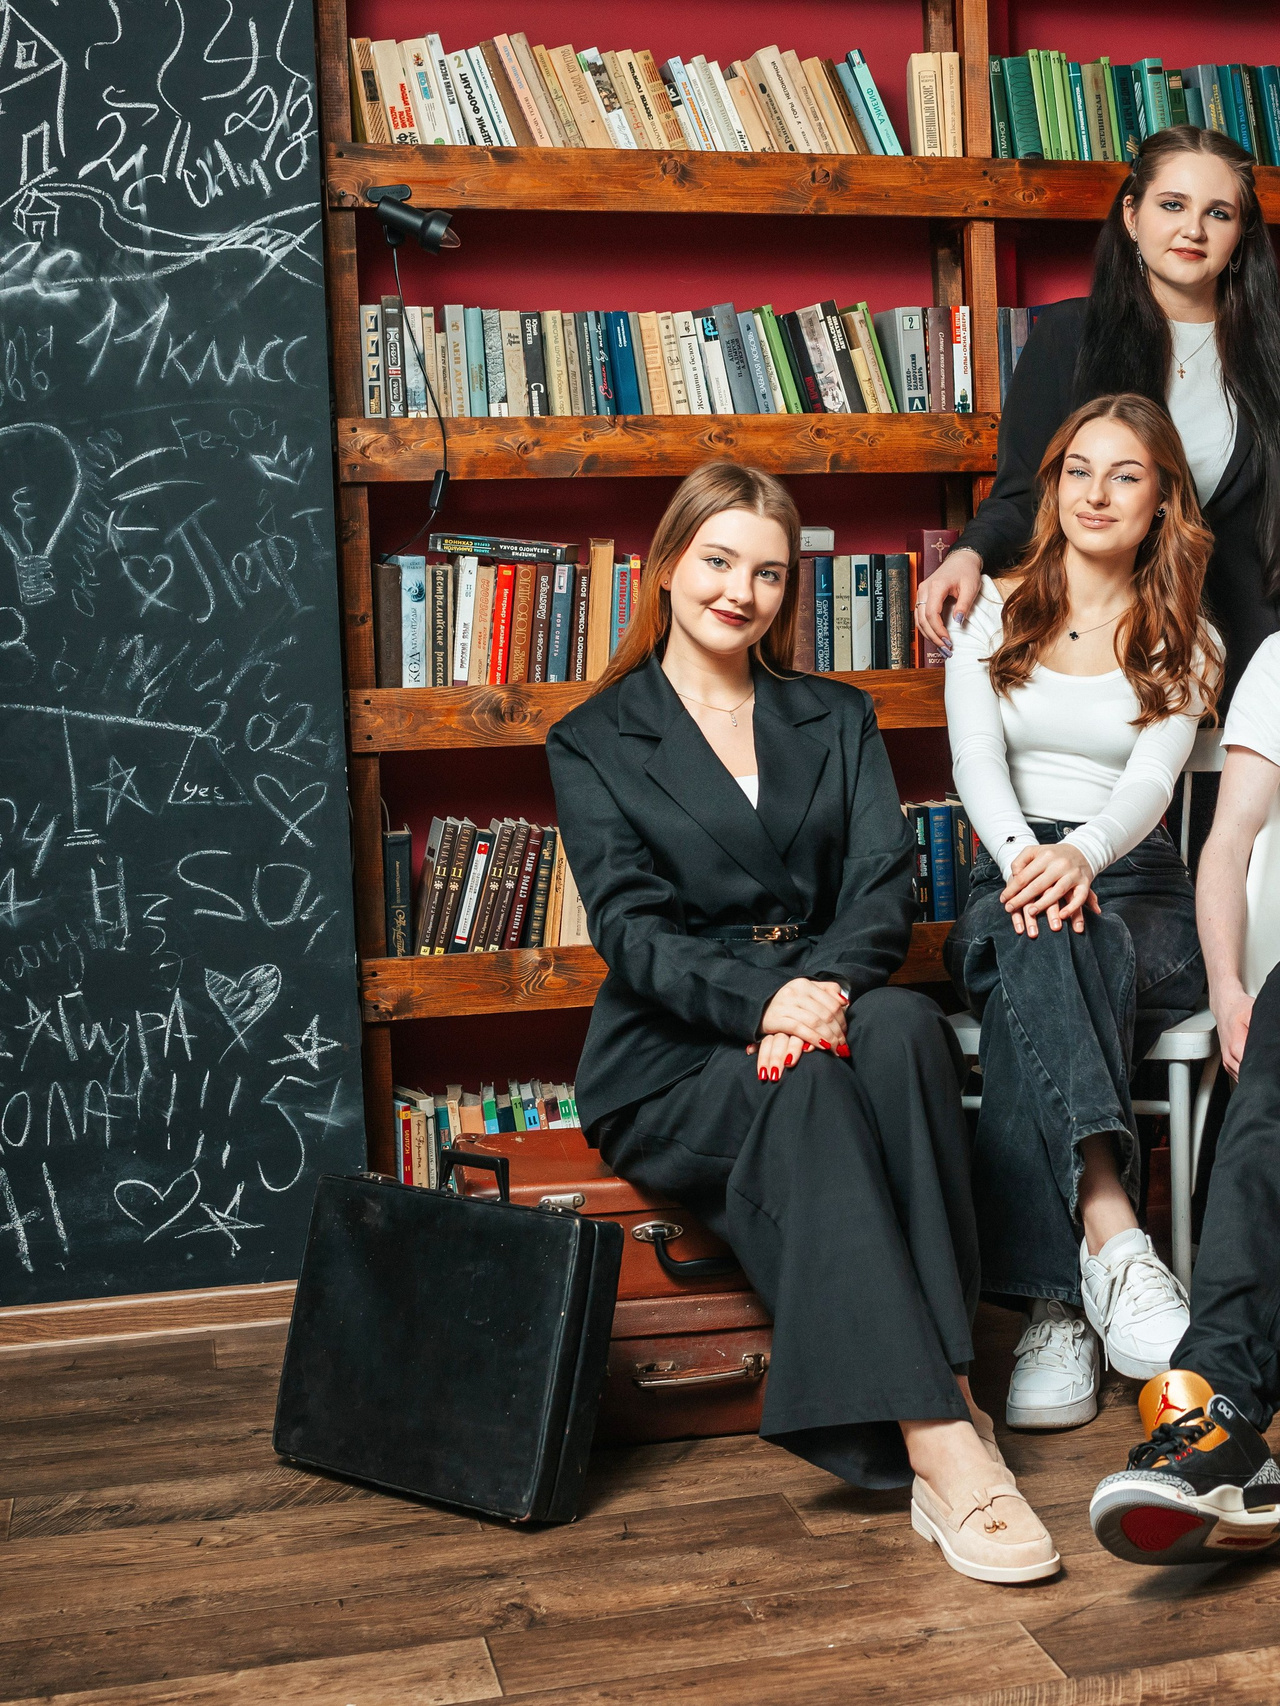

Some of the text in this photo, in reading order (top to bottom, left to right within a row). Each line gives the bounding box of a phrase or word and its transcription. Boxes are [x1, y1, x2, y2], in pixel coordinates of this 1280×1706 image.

[561, 48, 577, 74] КОЧЕТОВ
[628, 62, 644, 94] ГОРЯЧАЯ
[417, 72, 431, 100] ВЕСЬ МИР
[438, 59, 456, 105] ИСТОРИЯ РОССИИ
[454, 55, 480, 115] ФОРСАЙТ 2
[770, 60, 792, 100] НЕПОКОРНОЙ
[389, 106, 400, 130] РАССКАЗЫ
[766, 93, 778, 118] весна
[789, 101, 798, 120] ГОРЫ
[866, 87, 885, 126] ФИЗИКА
[921, 85, 937, 150] КАМЕННЫЙ ПОЯС
[1095, 94, 1107, 149] КЕТЛИНСКАЯ
[776, 116, 790, 145] Ранняя
[999, 121, 1008, 149] МАНОВ
[525, 319, 534, 344] СЕРГЕЕВ
[826, 316, 841, 352] ПОЛЬСКИЙ
[832, 316, 846, 350] ДЕТЕКТИВ
[908, 316, 914, 328] 2
[556, 370, 564, 392] Любовь
[596, 350, 613, 400] Есенин без
[748, 332, 766, 395] ЗАБЫТАЯ ЛЮБОВЬ
[693, 374, 704, 410] Женщина
[444, 538, 474, 546] СУХИНОВ
[436, 568, 444, 646] австралийские
[478, 578, 490, 624] ТРЕВОГА
[514, 568, 532, 645] СЛОВО ДЕЛО
[618, 570, 628, 625] ОПЕРАЦИЯ
[874, 568, 884, 622] Гарольд Роббинс
[410, 607, 418, 650] АТЛАНТИДЫ
[536, 576, 548, 662] КРАСАВИН Мастера
[460, 622, 470, 668] РУССКИЙ ЯЗЫК
[576, 636, 584, 682] УГОЛОВНОГО
[518, 650, 526, 682] ПИКУЛЬ
[183, 779, 227, 799] yes
[440, 826, 454, 866] ХИМИЯ
[456, 827, 470, 866] ХИМИЯ
[496, 828, 512, 866] ХИМИЯ
[512, 826, 528, 866] ХИМИЯ
[434, 866, 448, 877] 11
[450, 866, 463, 878] 11
[491, 866, 503, 878] 11
[506, 865, 518, 876] 11
[520, 875, 530, 898] СТАРОЕ
[528, 1115, 538, 1126] 11
[562, 1106, 569, 1114] 11
